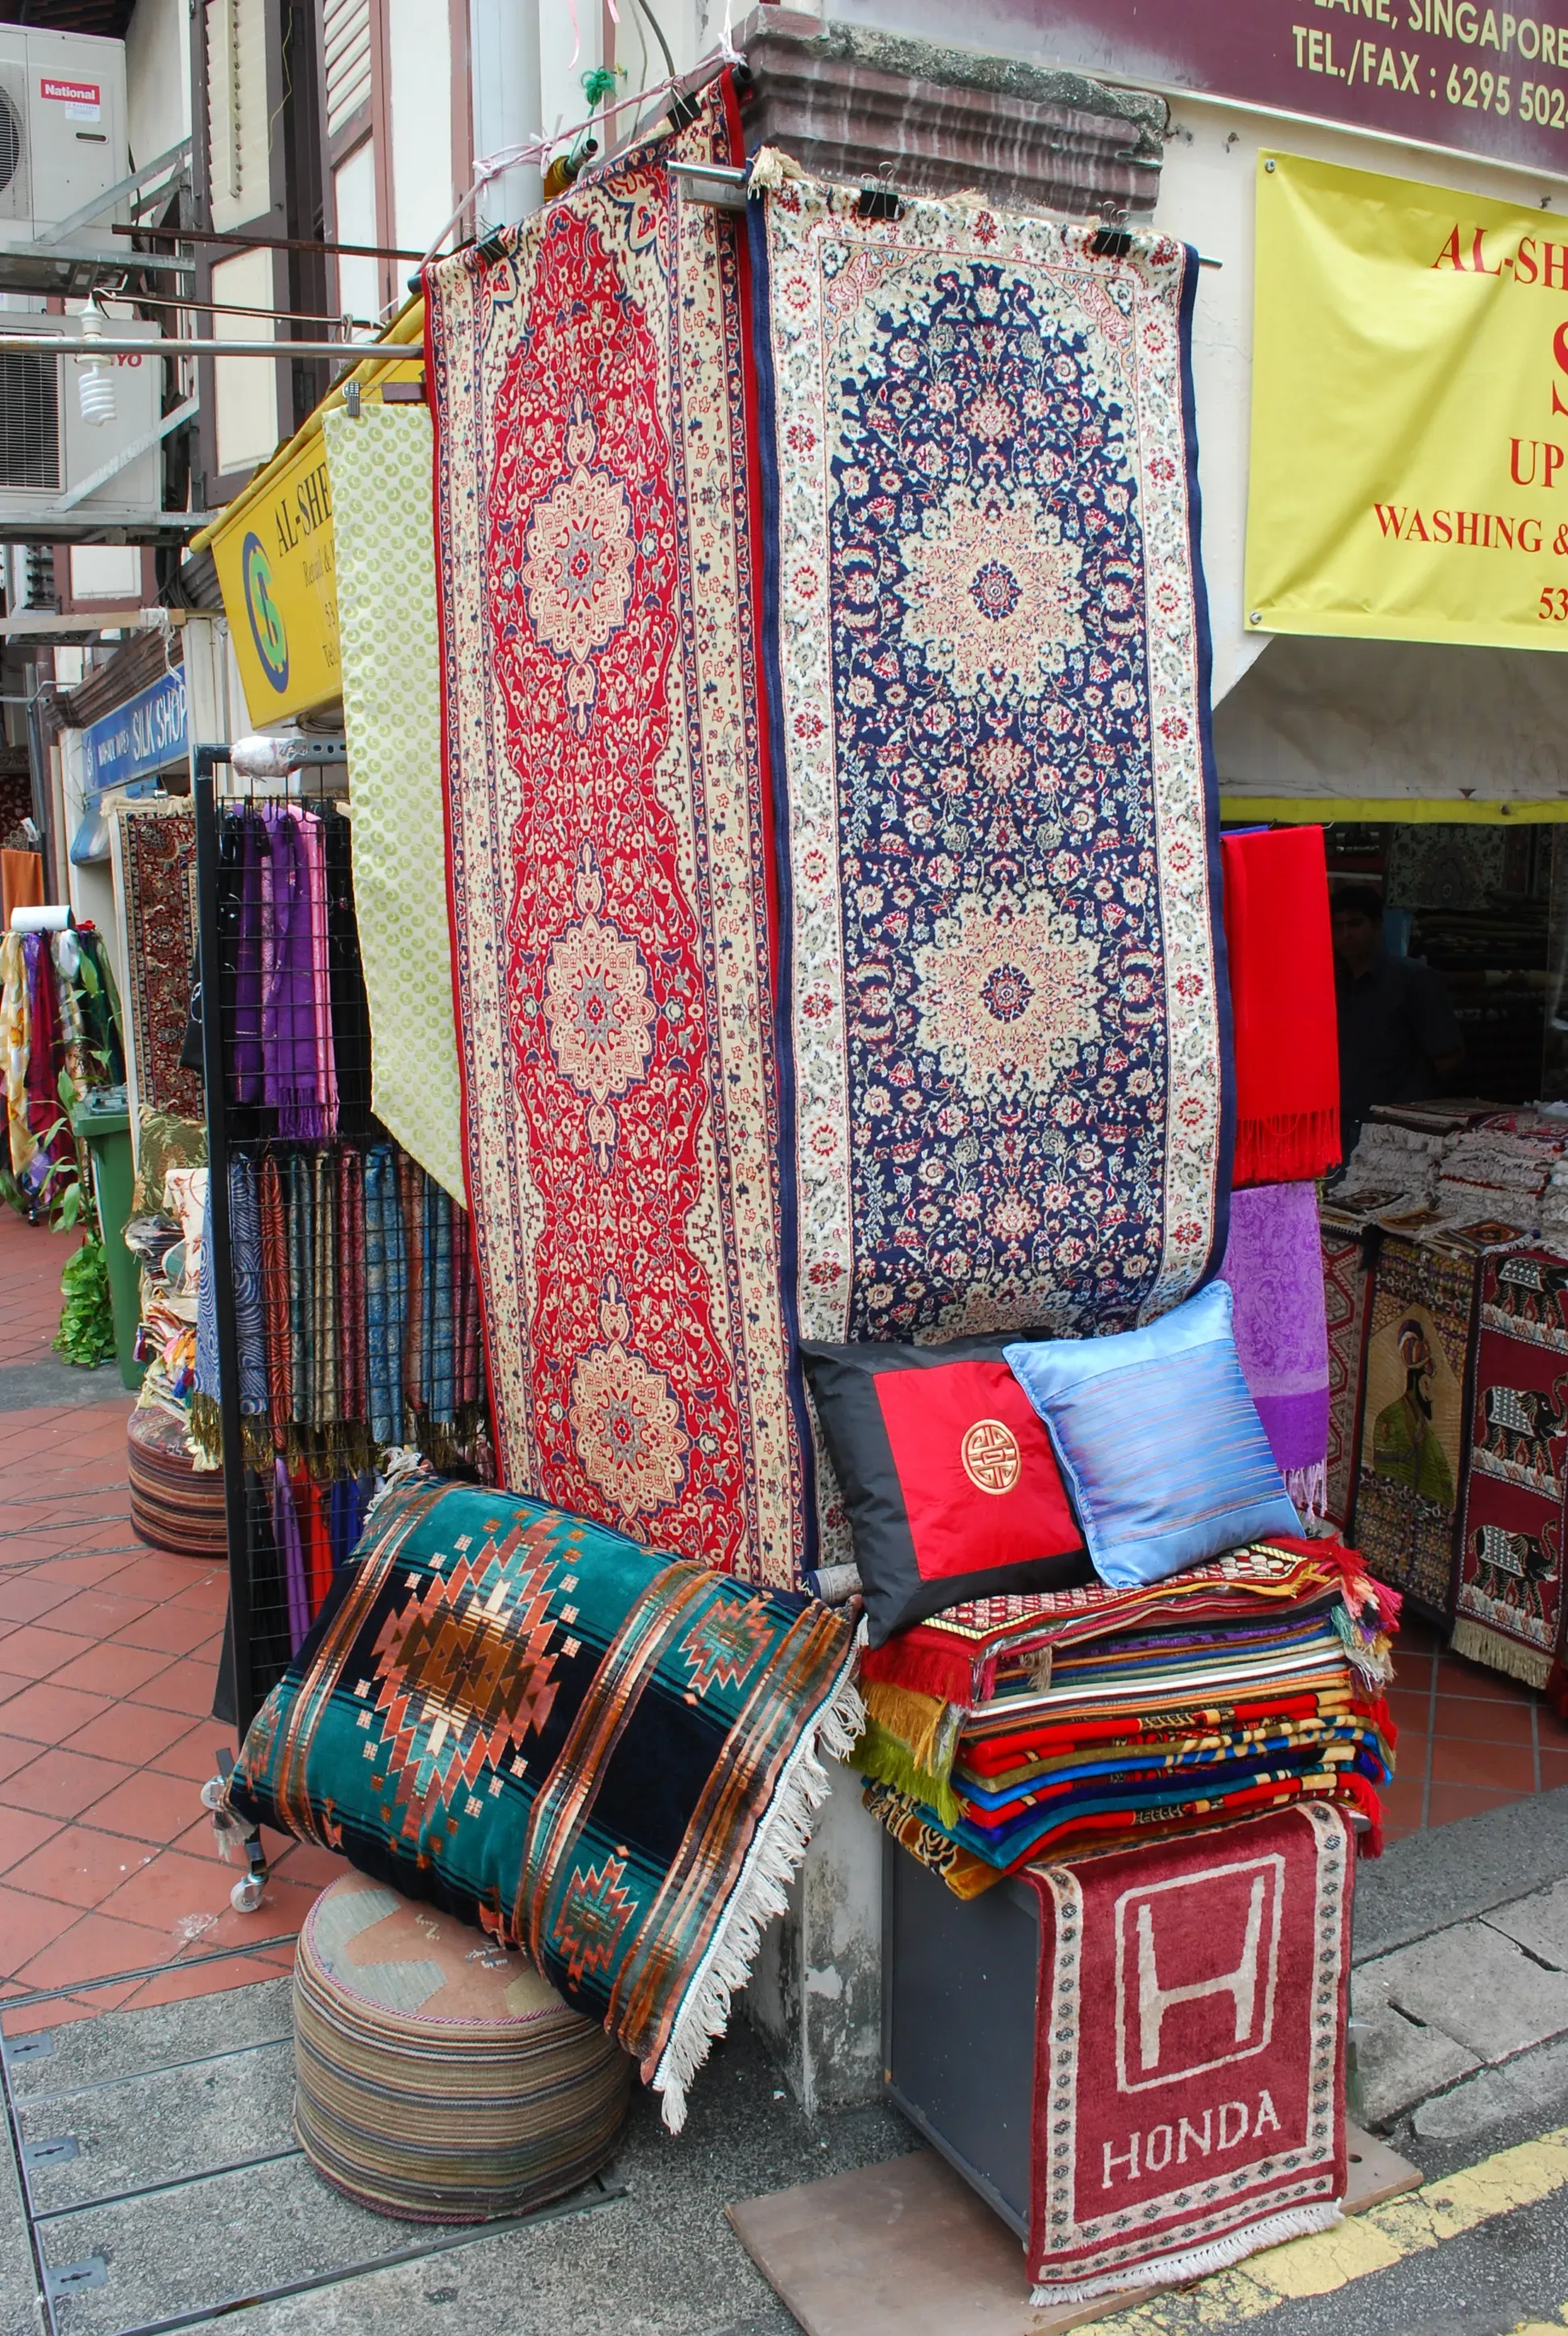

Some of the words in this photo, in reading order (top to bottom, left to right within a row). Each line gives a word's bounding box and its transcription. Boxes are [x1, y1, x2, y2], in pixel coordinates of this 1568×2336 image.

[1408, 0, 1568, 68] SINGAPORE
[44, 83, 95, 100] National
[1292, 25, 1420, 94] TEL./FAX
[1446, 63, 1510, 115] 6295
[1518, 81, 1568, 129] 502
[1430, 223, 1568, 291] AL-SH
[1509, 437, 1565, 489] UP
[274, 461, 332, 558] AL-SHE
[1374, 503, 1543, 553] WASHING
[1538, 587, 1568, 621] 53
[132, 701, 156, 761] SILK
[156, 684, 186, 749] SHOP
[1102, 2089, 1281, 2189] HONDA
